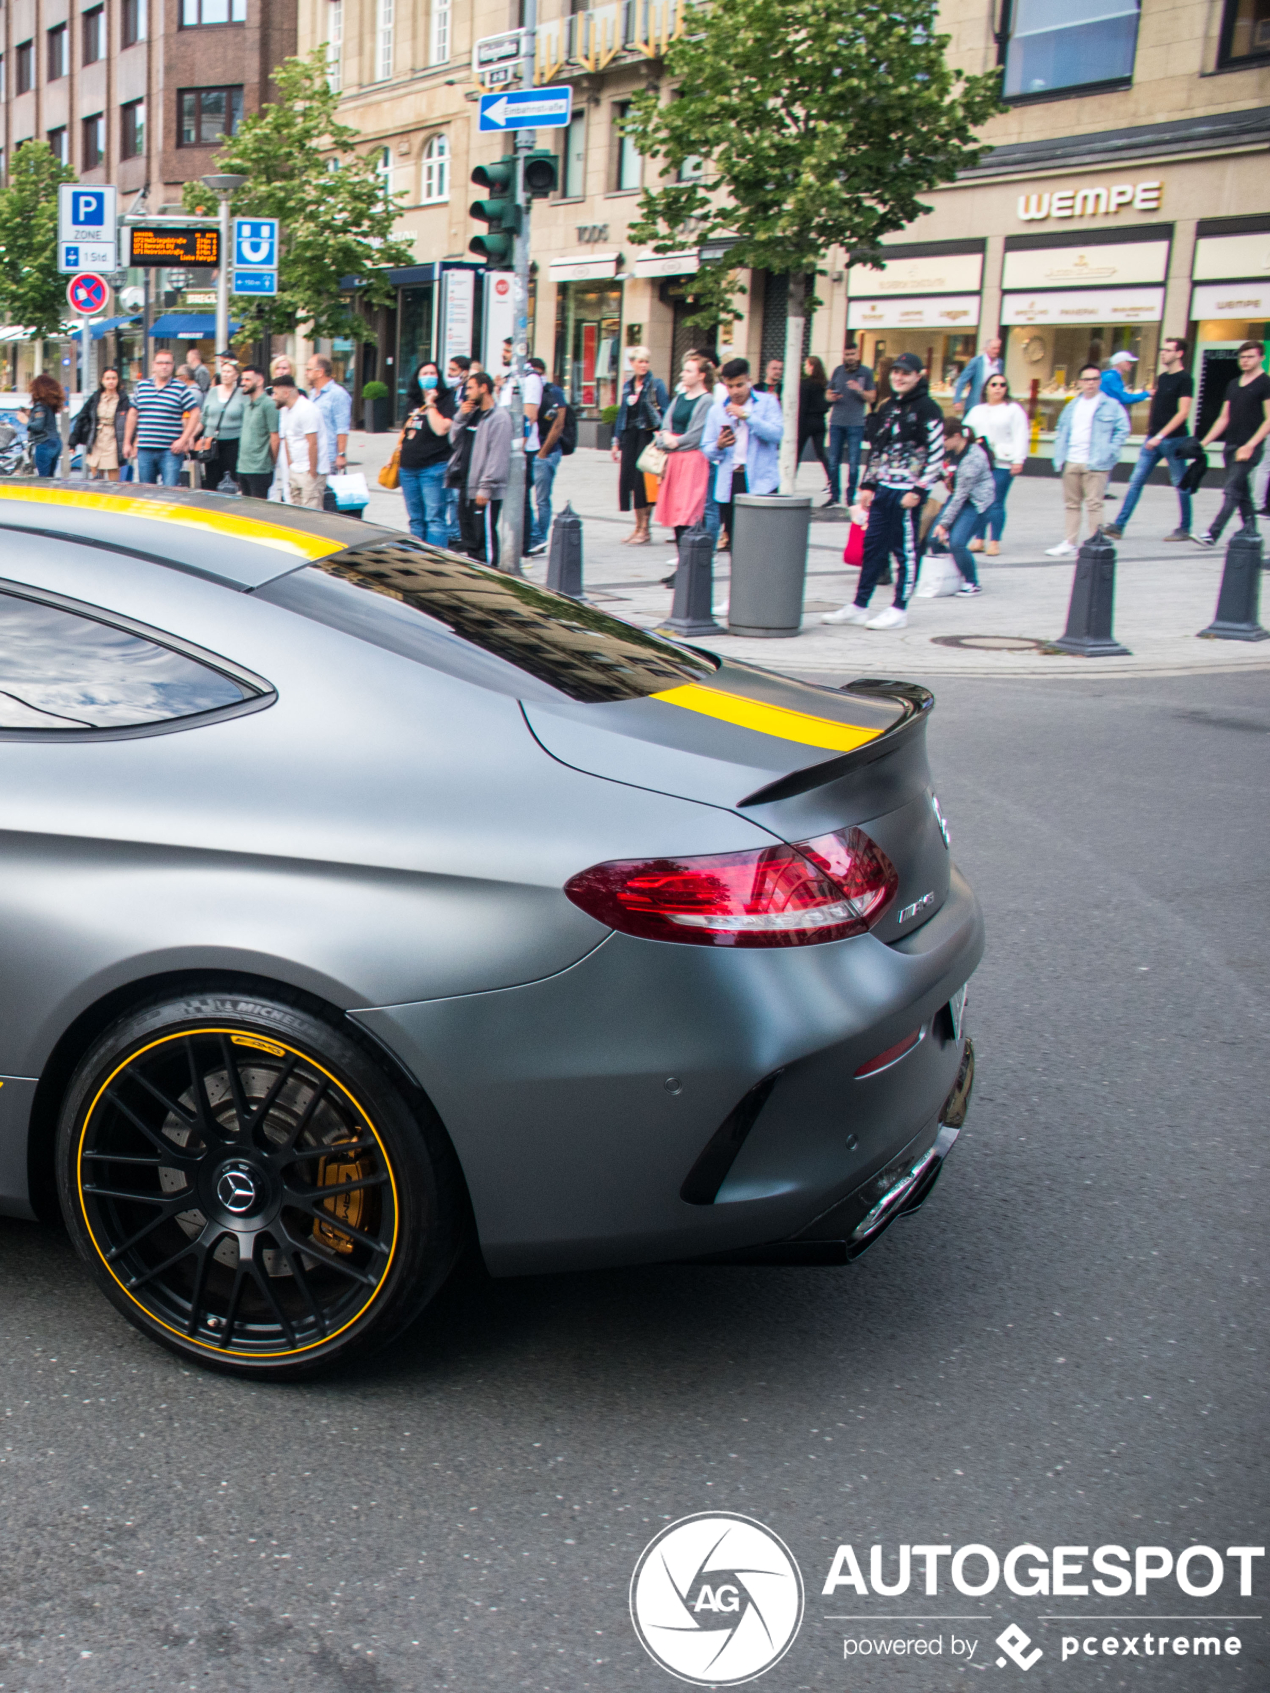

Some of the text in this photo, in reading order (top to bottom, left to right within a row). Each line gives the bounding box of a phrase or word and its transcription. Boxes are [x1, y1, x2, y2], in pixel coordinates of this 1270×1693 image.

[504, 102, 565, 115] Einbahnstraße
[1017, 181, 1164, 221] WEMPE
[79, 195, 98, 222] P
[73, 229, 103, 240] ZONE
[1216, 300, 1261, 309] WEMPE
